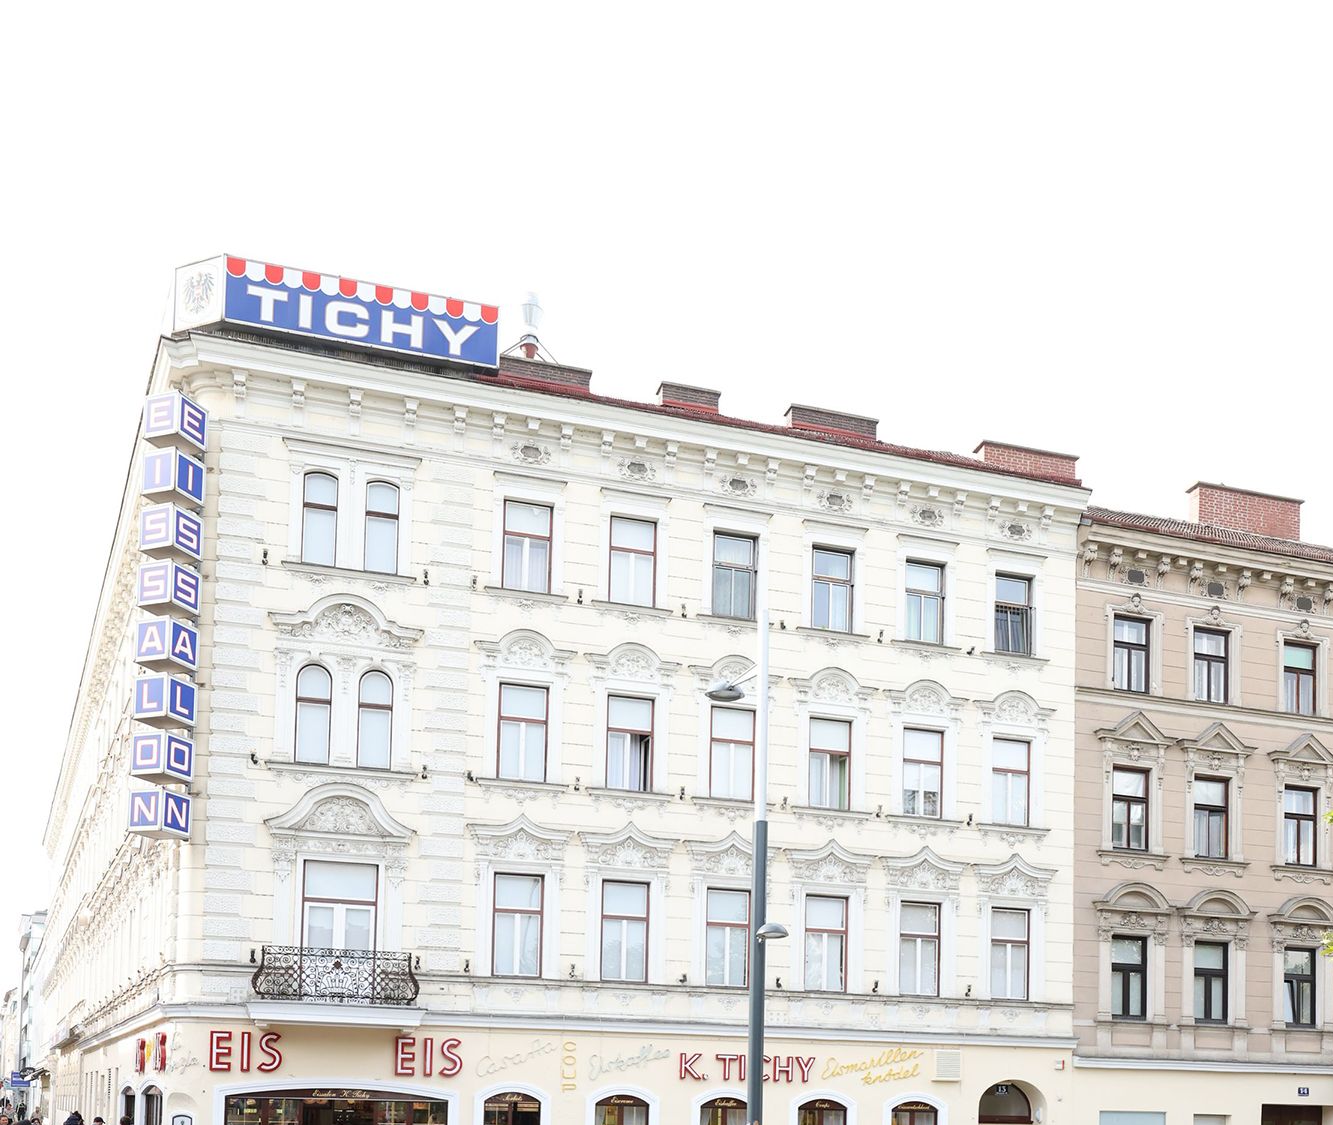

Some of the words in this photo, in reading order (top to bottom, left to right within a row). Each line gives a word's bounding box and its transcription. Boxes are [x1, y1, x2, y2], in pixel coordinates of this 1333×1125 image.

[246, 284, 482, 357] TICHY
[132, 400, 172, 824] EISSALON
[165, 404, 203, 829] EISSALON
[209, 1030, 283, 1073] EIS
[394, 1036, 463, 1077] EIS
